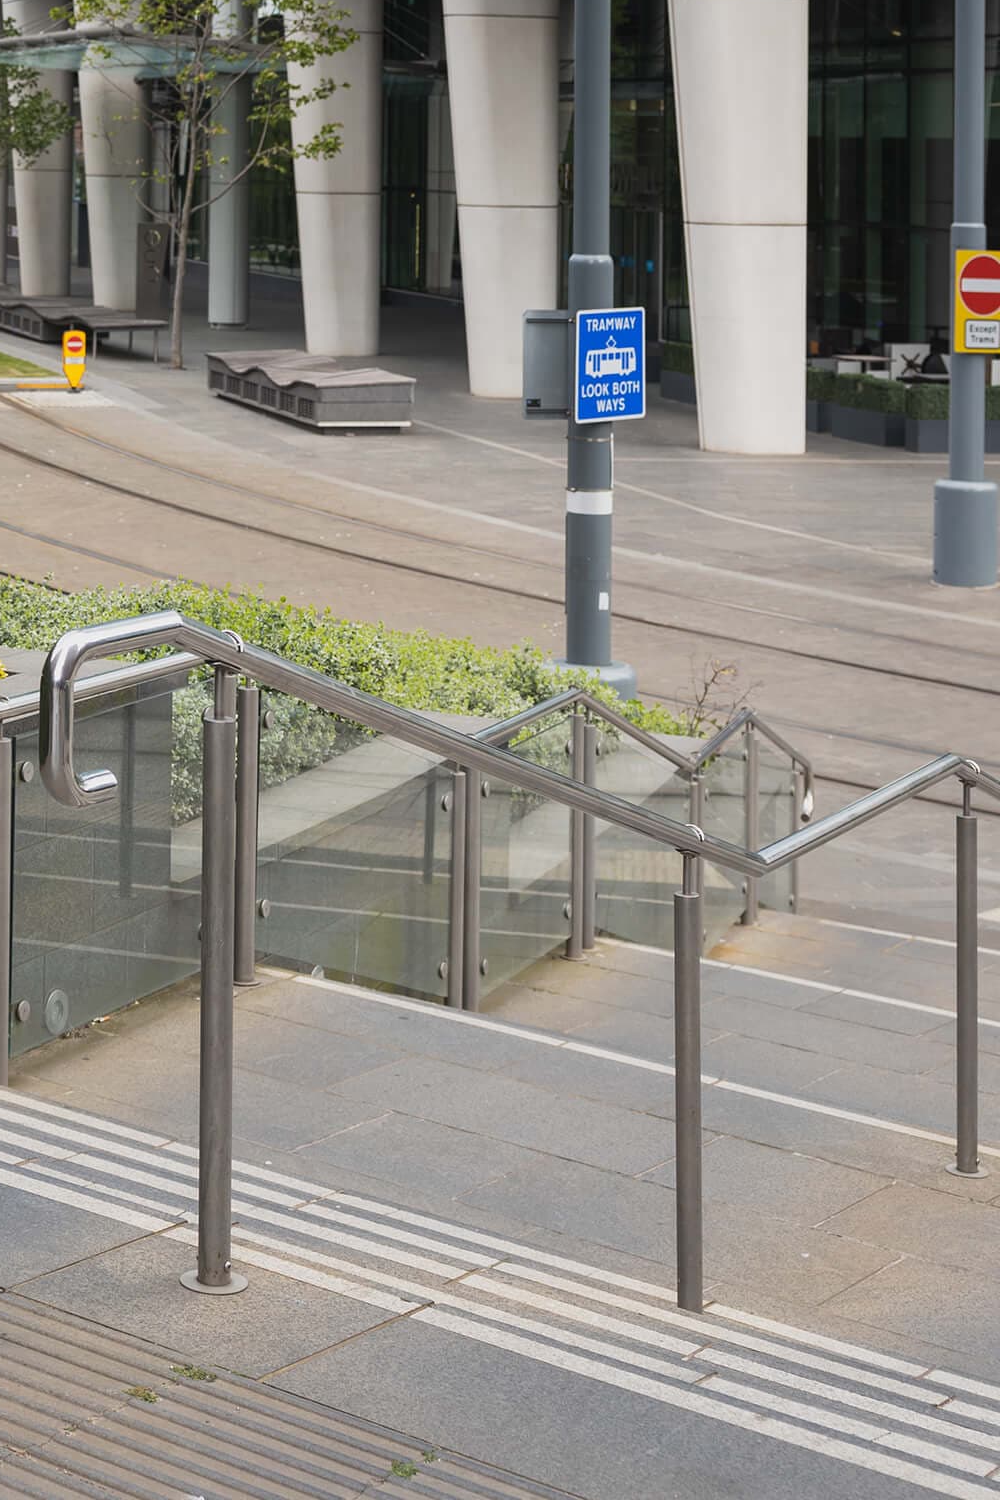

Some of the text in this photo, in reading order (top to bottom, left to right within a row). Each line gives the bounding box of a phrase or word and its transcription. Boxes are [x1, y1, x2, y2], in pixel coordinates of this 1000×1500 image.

[586, 316, 636, 332] TRAMWAY
[970, 324, 997, 334] Except
[970, 334, 994, 343] Trams
[581, 380, 640, 398] LOOK BOTH
[596, 398, 625, 412] WAYS
